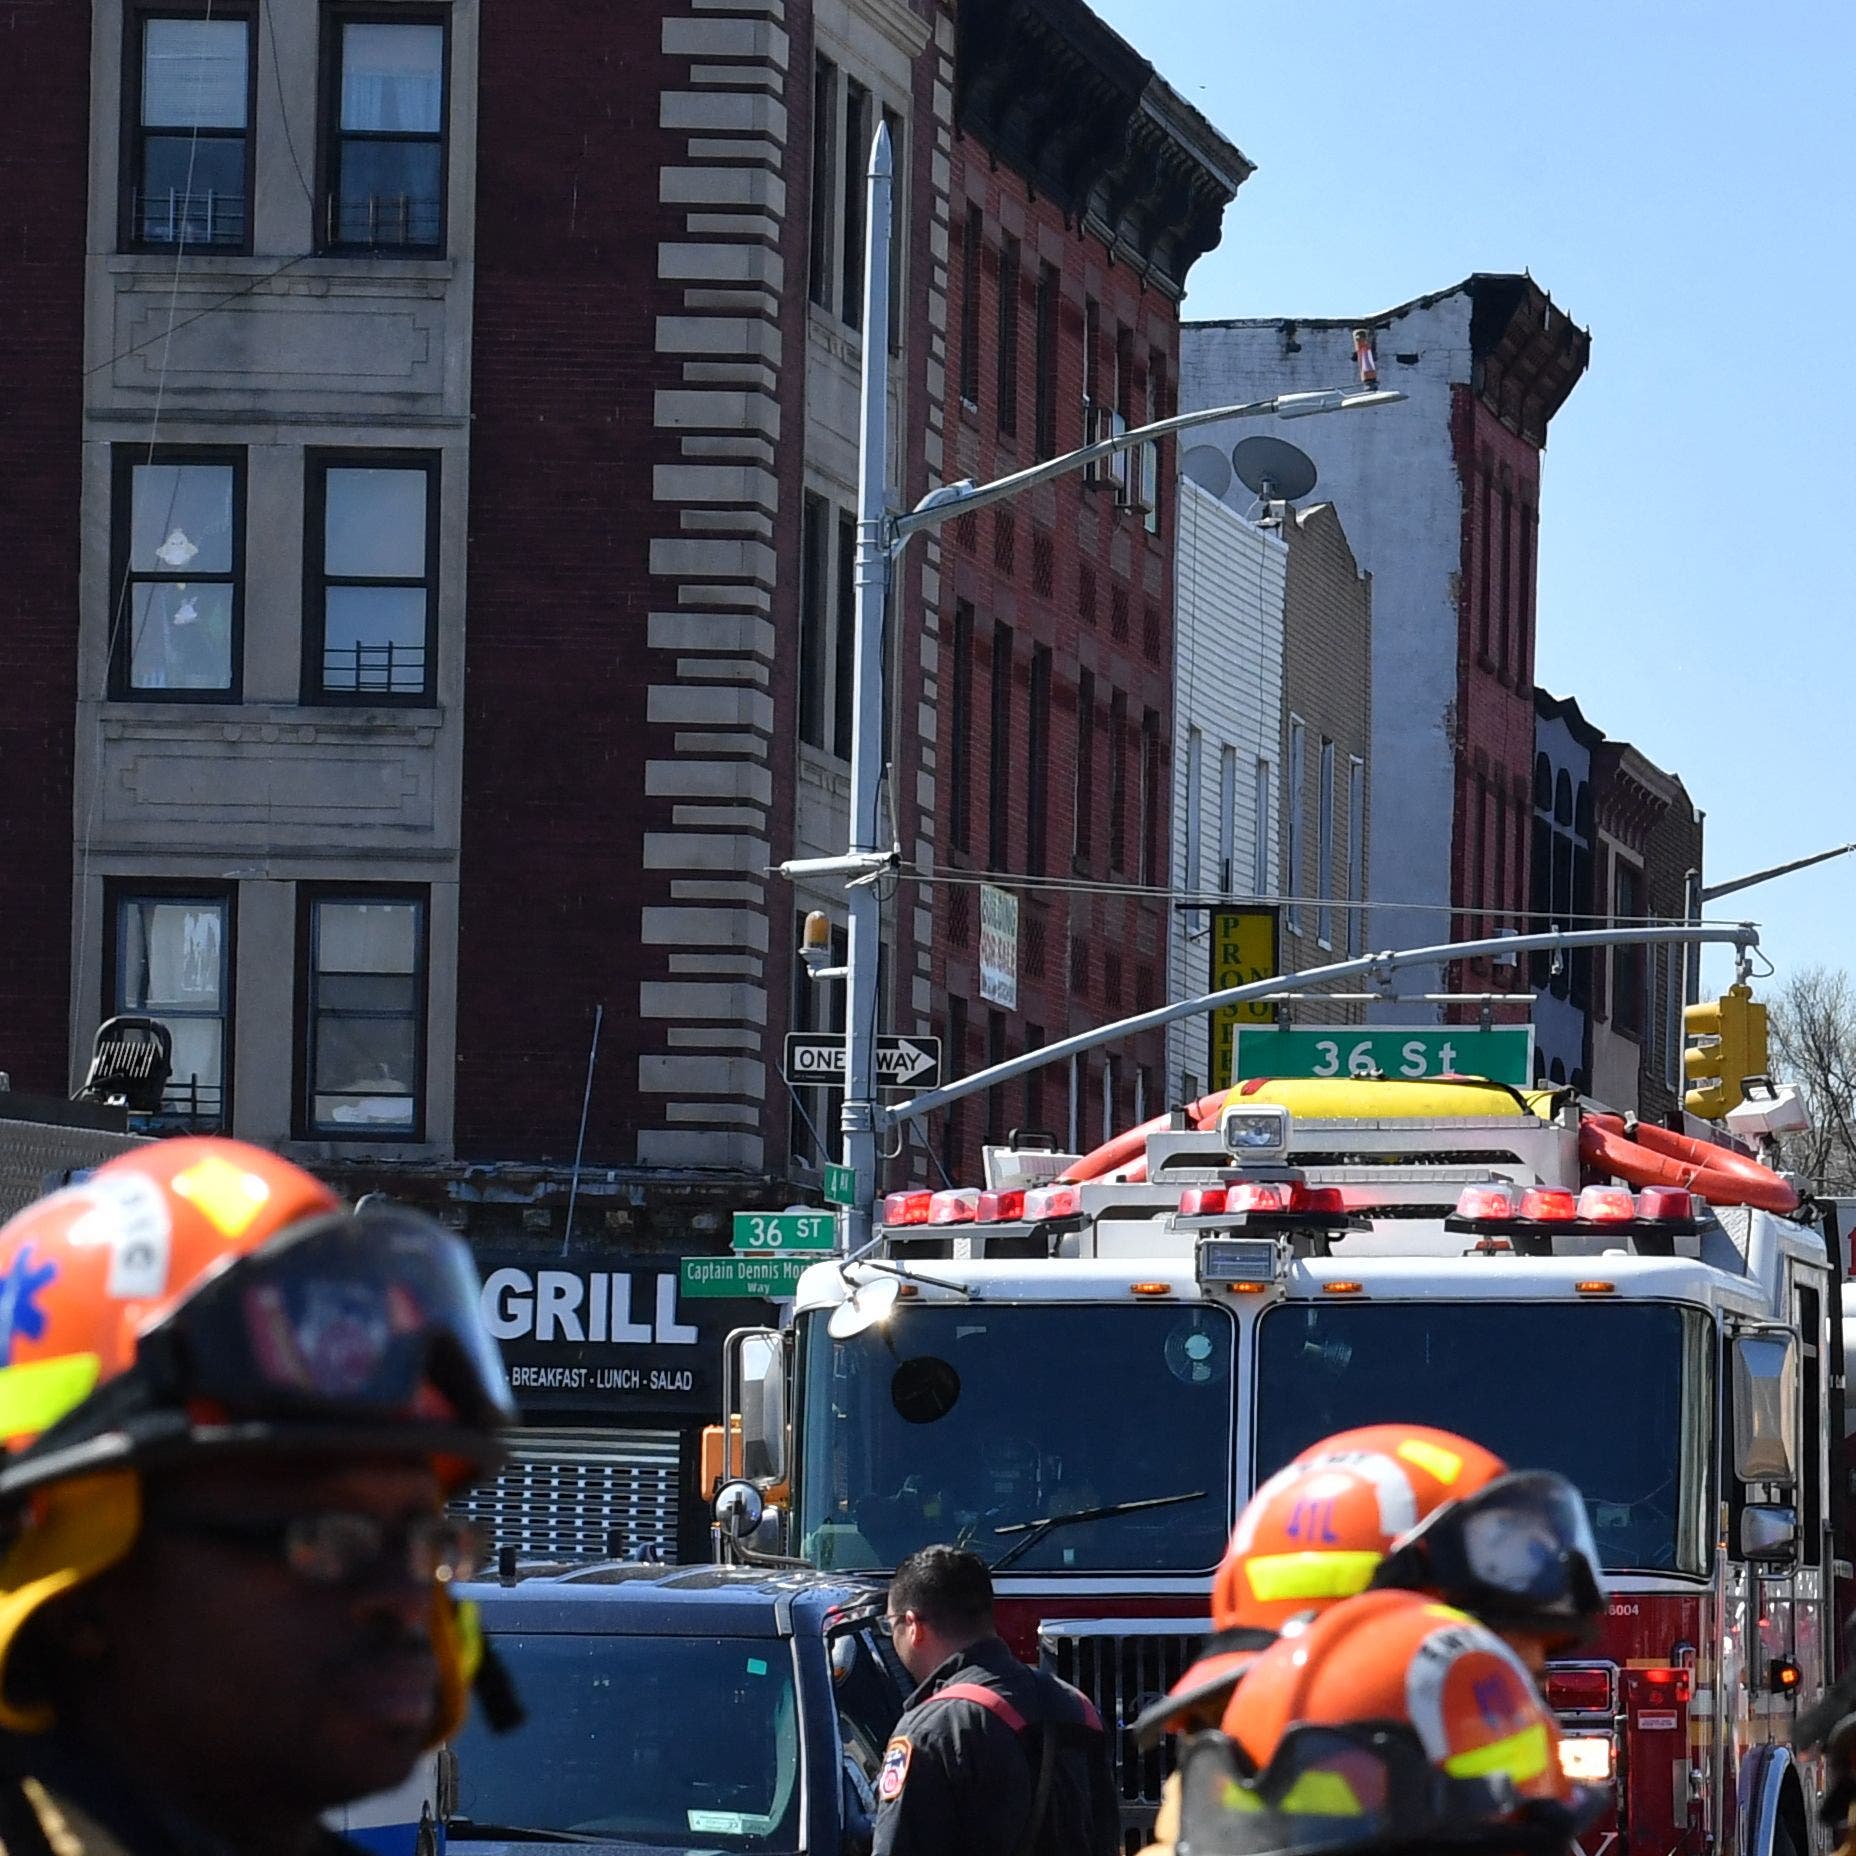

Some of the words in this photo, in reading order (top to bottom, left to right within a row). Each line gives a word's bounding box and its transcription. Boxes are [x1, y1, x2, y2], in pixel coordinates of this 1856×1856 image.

[799, 1048, 846, 1070] ONE
[875, 1052, 921, 1072] WAY
[1312, 1040, 1377, 1077] 36
[1400, 1040, 1457, 1077] St
[830, 1173, 837, 1198] 4
[749, 1217, 783, 1247] 36
[796, 1218, 822, 1238] ST
[687, 1261, 734, 1284] Captain
[738, 1262, 779, 1280] Dennis
[747, 1282, 770, 1295] Way
[480, 1267, 699, 1345] GRILL
[512, 1366, 587, 1388] BREAKFAST
[597, 1369, 640, 1389] LUNCH
[650, 1370, 693, 1391] SALAD
